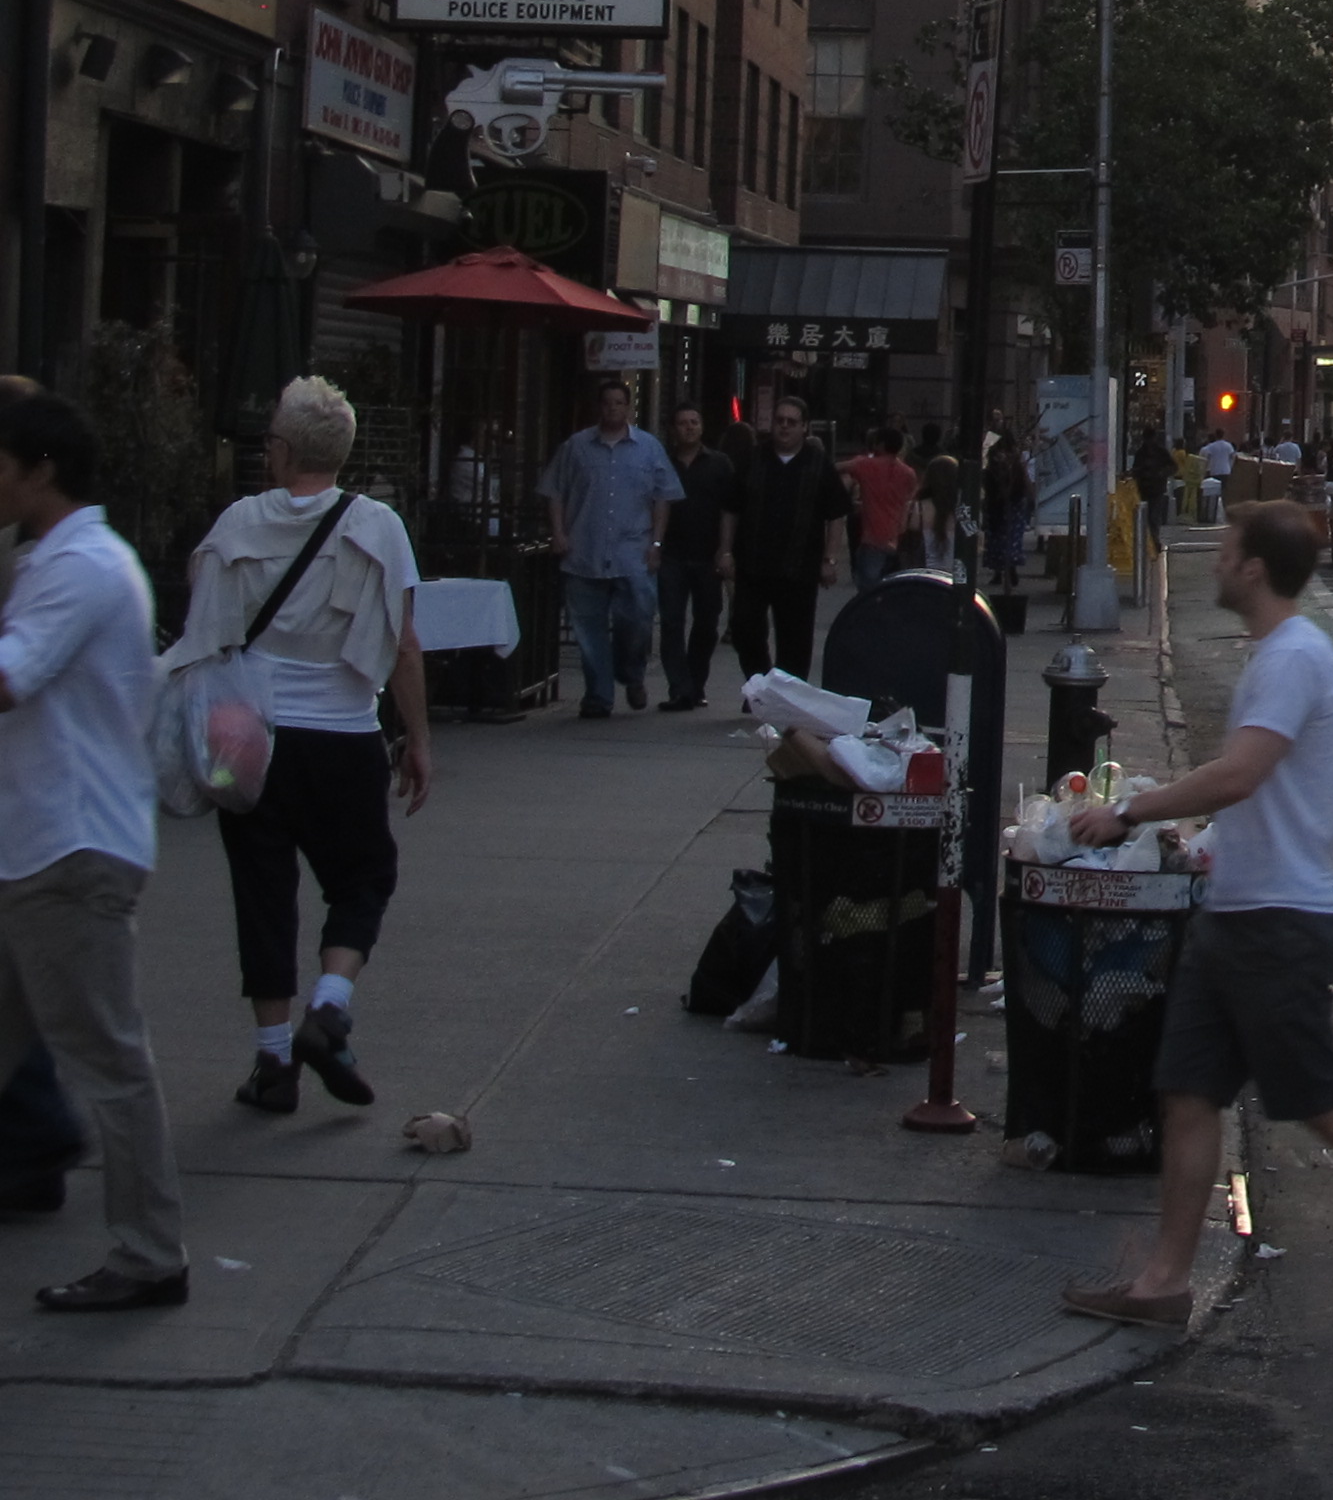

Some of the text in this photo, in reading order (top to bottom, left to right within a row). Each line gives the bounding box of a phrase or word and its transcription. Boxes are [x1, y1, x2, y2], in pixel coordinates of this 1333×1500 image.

[448, 1, 616, 21] POLICE EQUIPMENT
[315, 21, 343, 66] JOHN
[469, 191, 573, 247] FUEL
[608, 342, 654, 351] FOOT RUB
[894, 795, 928, 804] LITTER
[1100, 873, 1134, 883] ONLY
